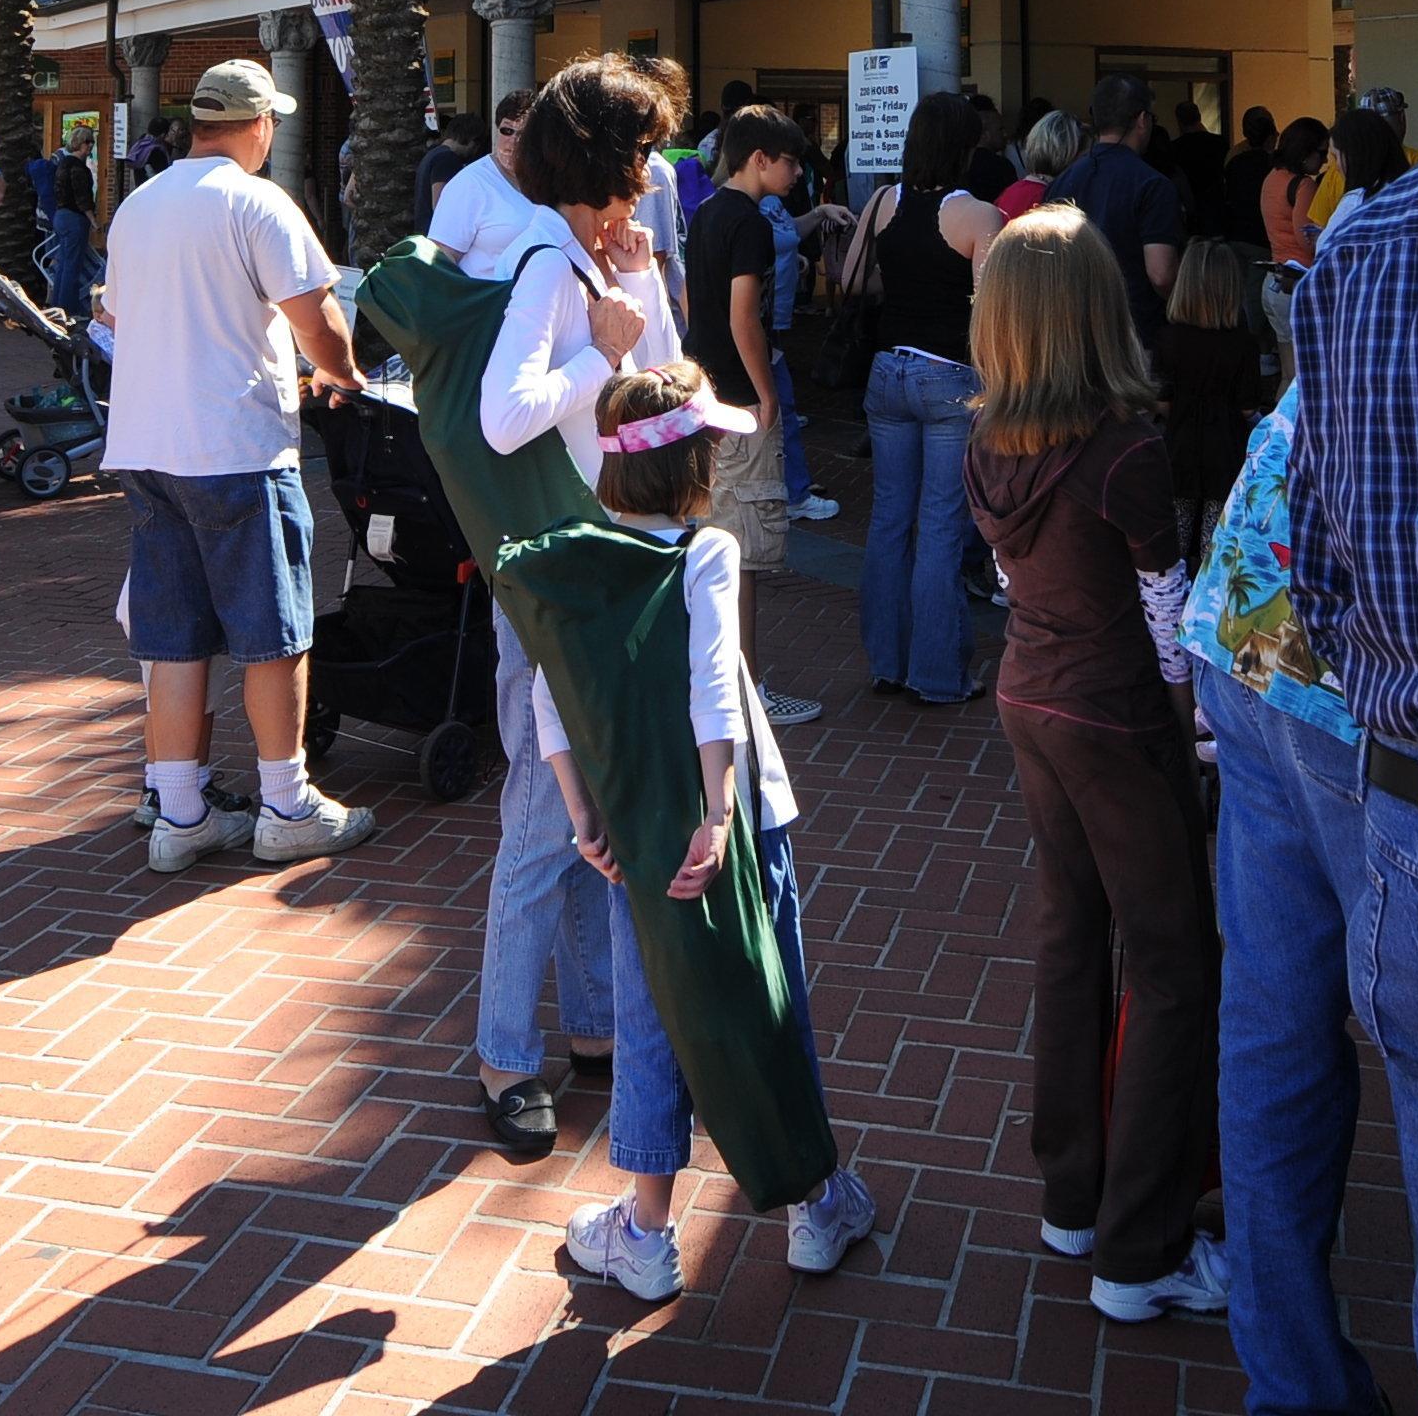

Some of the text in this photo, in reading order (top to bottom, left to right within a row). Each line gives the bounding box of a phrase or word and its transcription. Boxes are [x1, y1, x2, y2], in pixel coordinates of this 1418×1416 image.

[871, 85, 900, 96] HOURS
[882, 100, 909, 113] Friday
[881, 113, 900, 125] 4pm
[875, 129, 882, 139] &
[884, 129, 907, 138] Sund
[881, 141, 900, 153] 5pm
[875, 156, 903, 167] Monda
